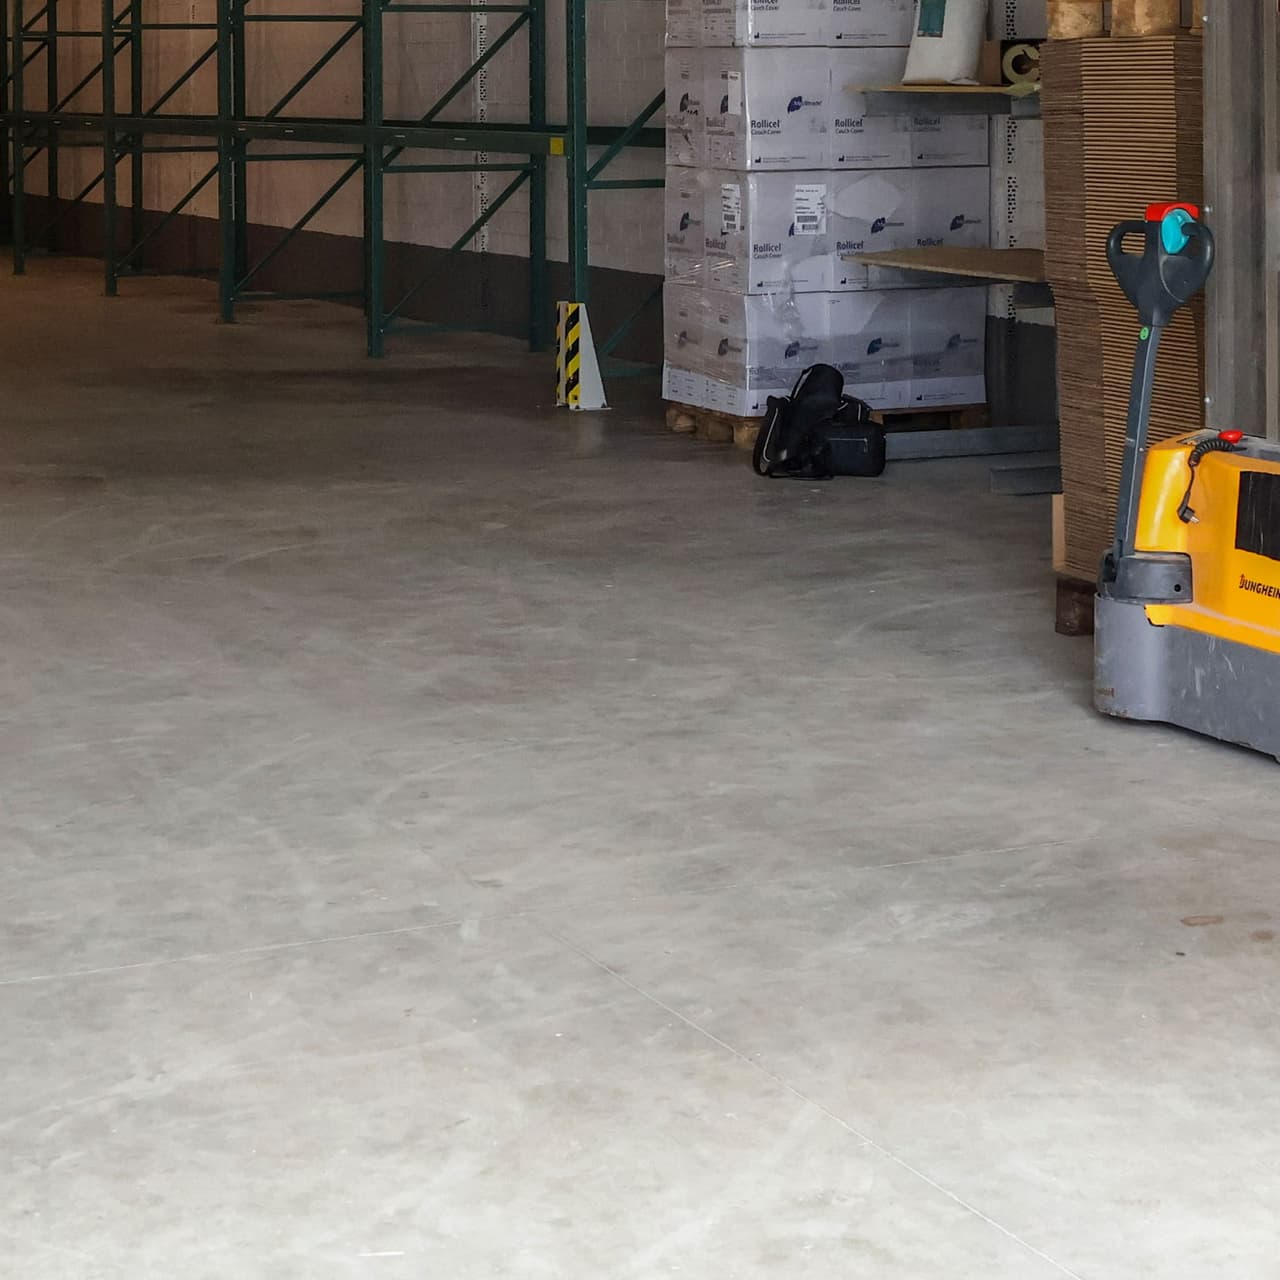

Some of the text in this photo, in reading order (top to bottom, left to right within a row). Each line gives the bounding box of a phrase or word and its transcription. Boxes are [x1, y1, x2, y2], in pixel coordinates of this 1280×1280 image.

[751, 119, 780, 129] Rollicel
[835, 118, 863, 128] Rollicel
[753, 242, 782, 253] Rollicel
[836, 240, 864, 251] Rollicel
[917, 238, 944, 247] Rollicel
